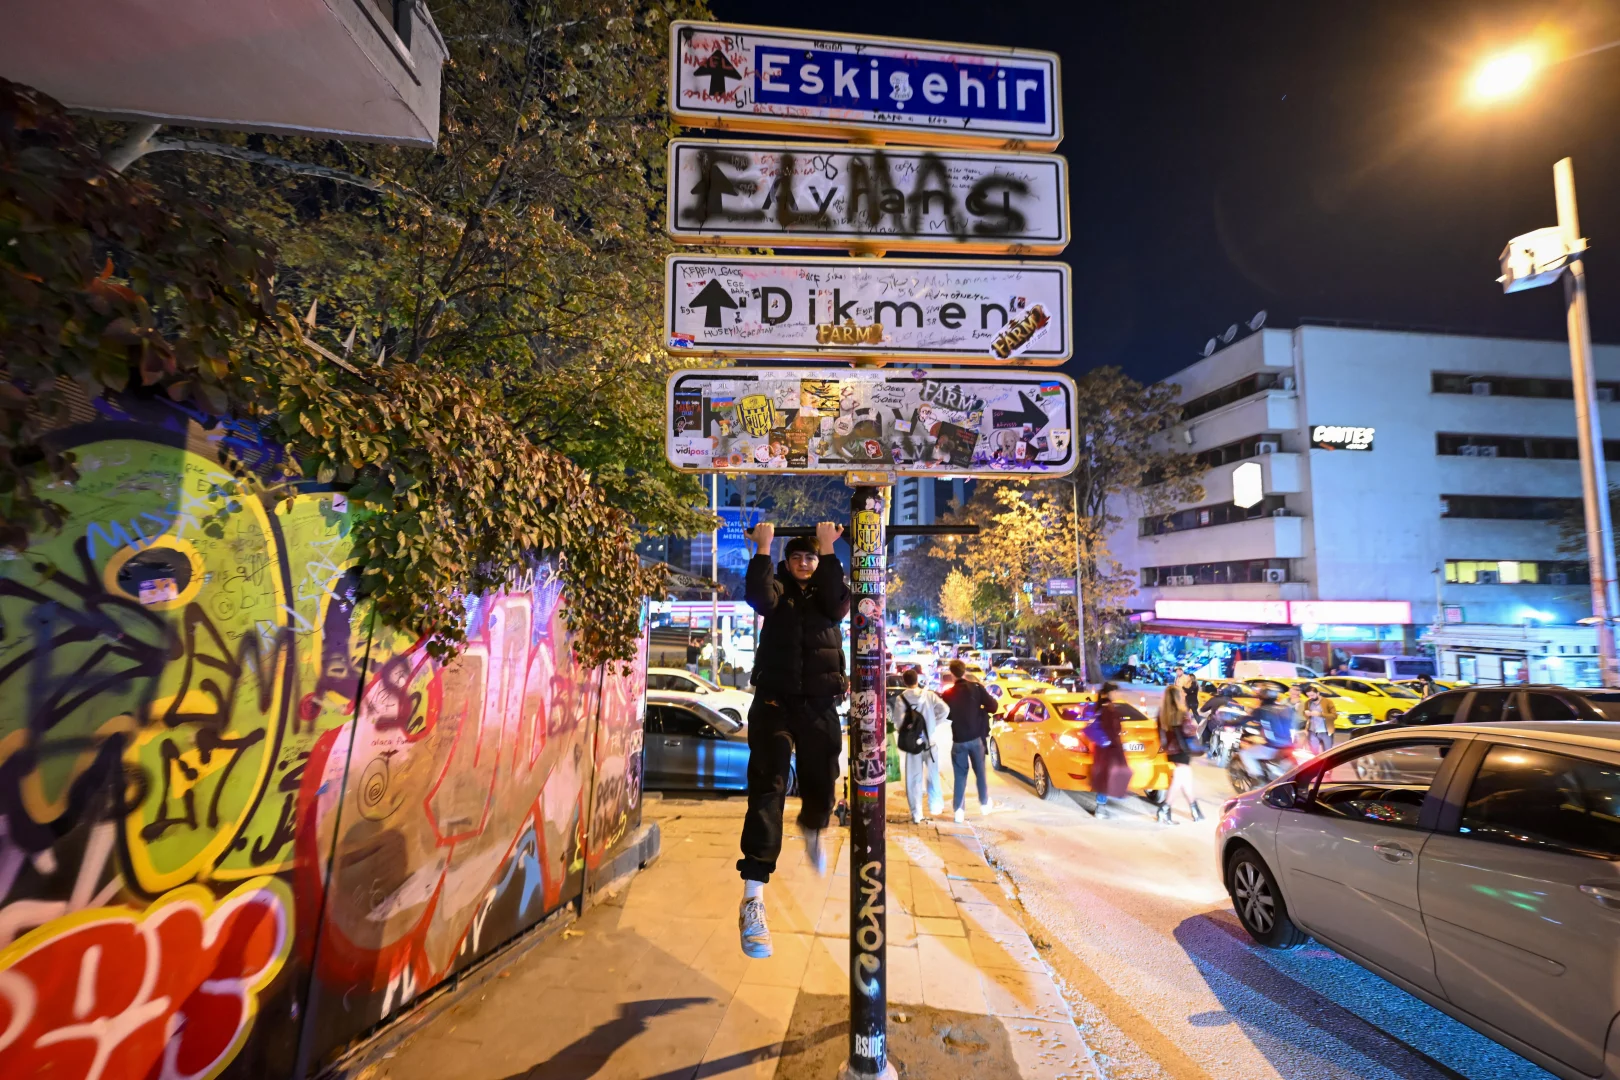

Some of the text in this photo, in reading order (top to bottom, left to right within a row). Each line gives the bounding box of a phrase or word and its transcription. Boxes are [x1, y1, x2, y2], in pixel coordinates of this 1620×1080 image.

[761, 53, 1039, 111] Eskişehir
[761, 287, 1008, 329] Dikmen
[820, 324, 871, 340] FARM
[992, 314, 1038, 356] FARM
[923, 380, 973, 410] FARM
[675, 447, 709, 457] vidipass
